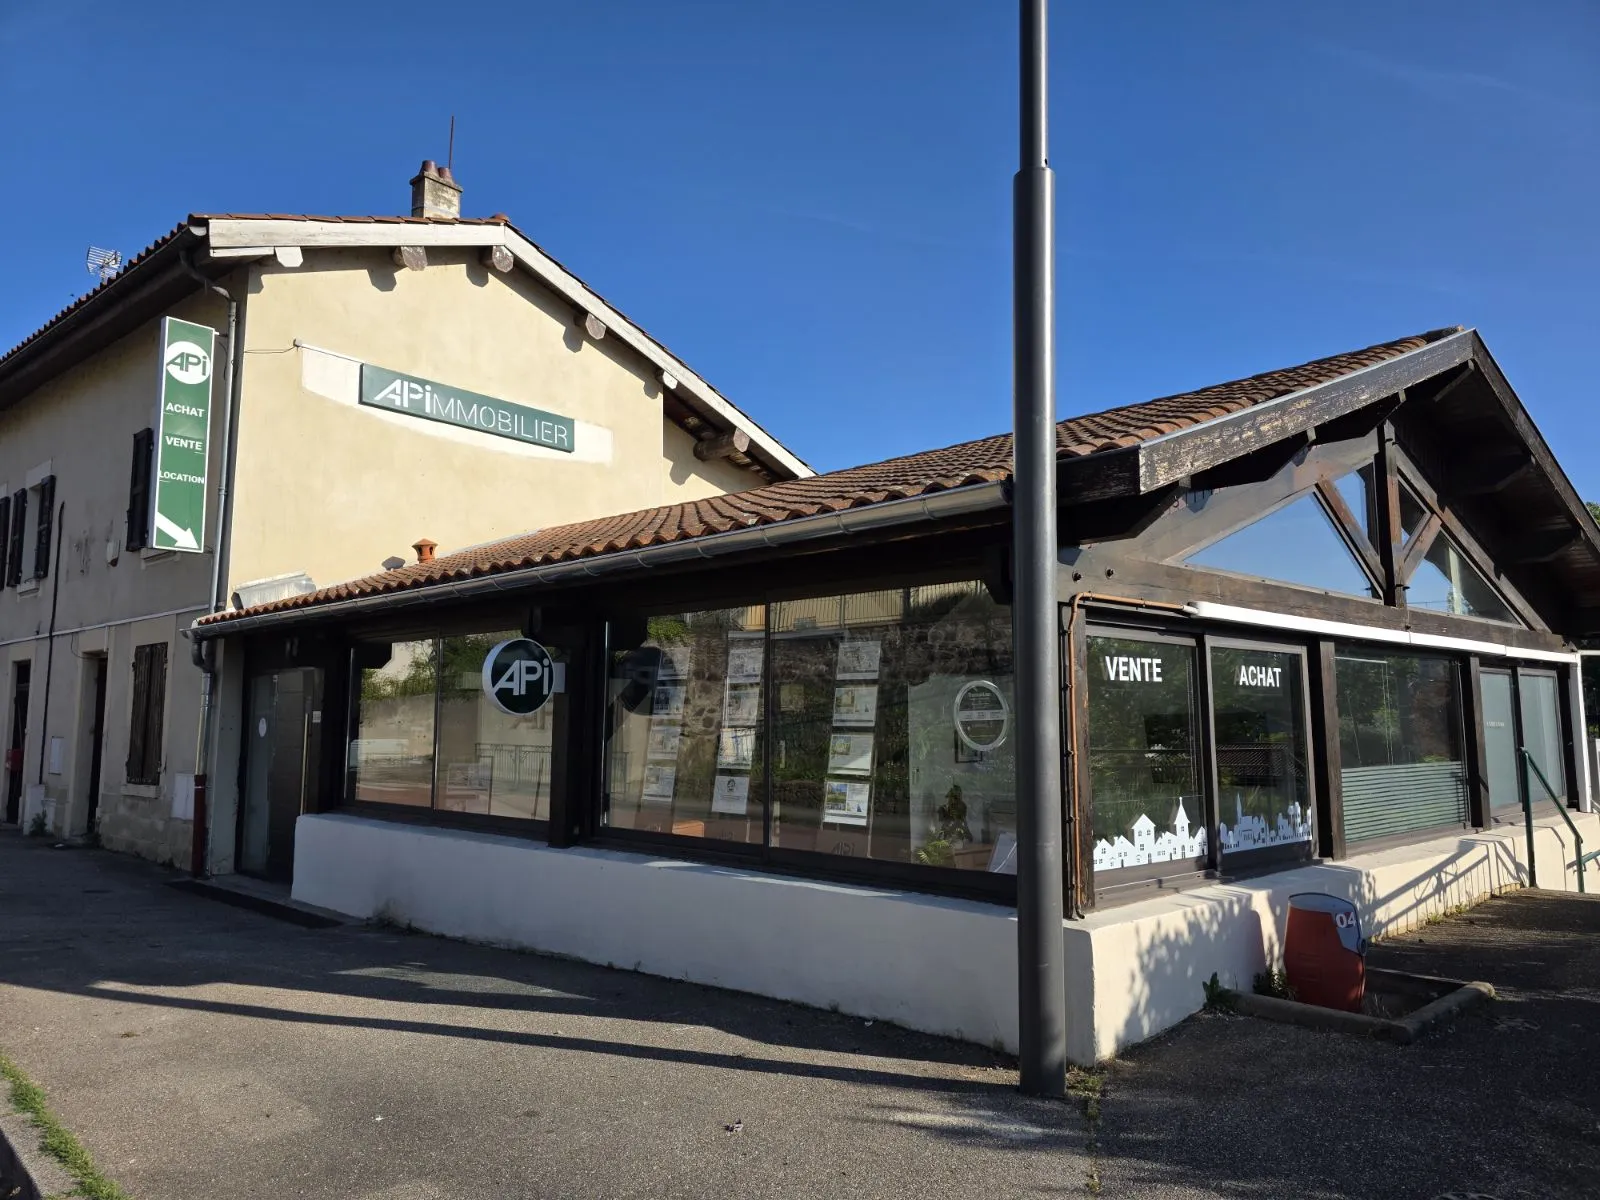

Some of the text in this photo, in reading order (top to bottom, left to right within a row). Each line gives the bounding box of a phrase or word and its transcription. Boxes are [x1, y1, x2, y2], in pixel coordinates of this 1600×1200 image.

[166, 351, 207, 376] APi
[165, 402, 205, 418] ACHAT
[165, 435, 203, 451] VENTE
[159, 470, 205, 485] LOCATION
[493, 658, 550, 696] APi
[1105, 655, 1163, 683] VENTE
[1239, 665, 1282, 688] ACHAT
